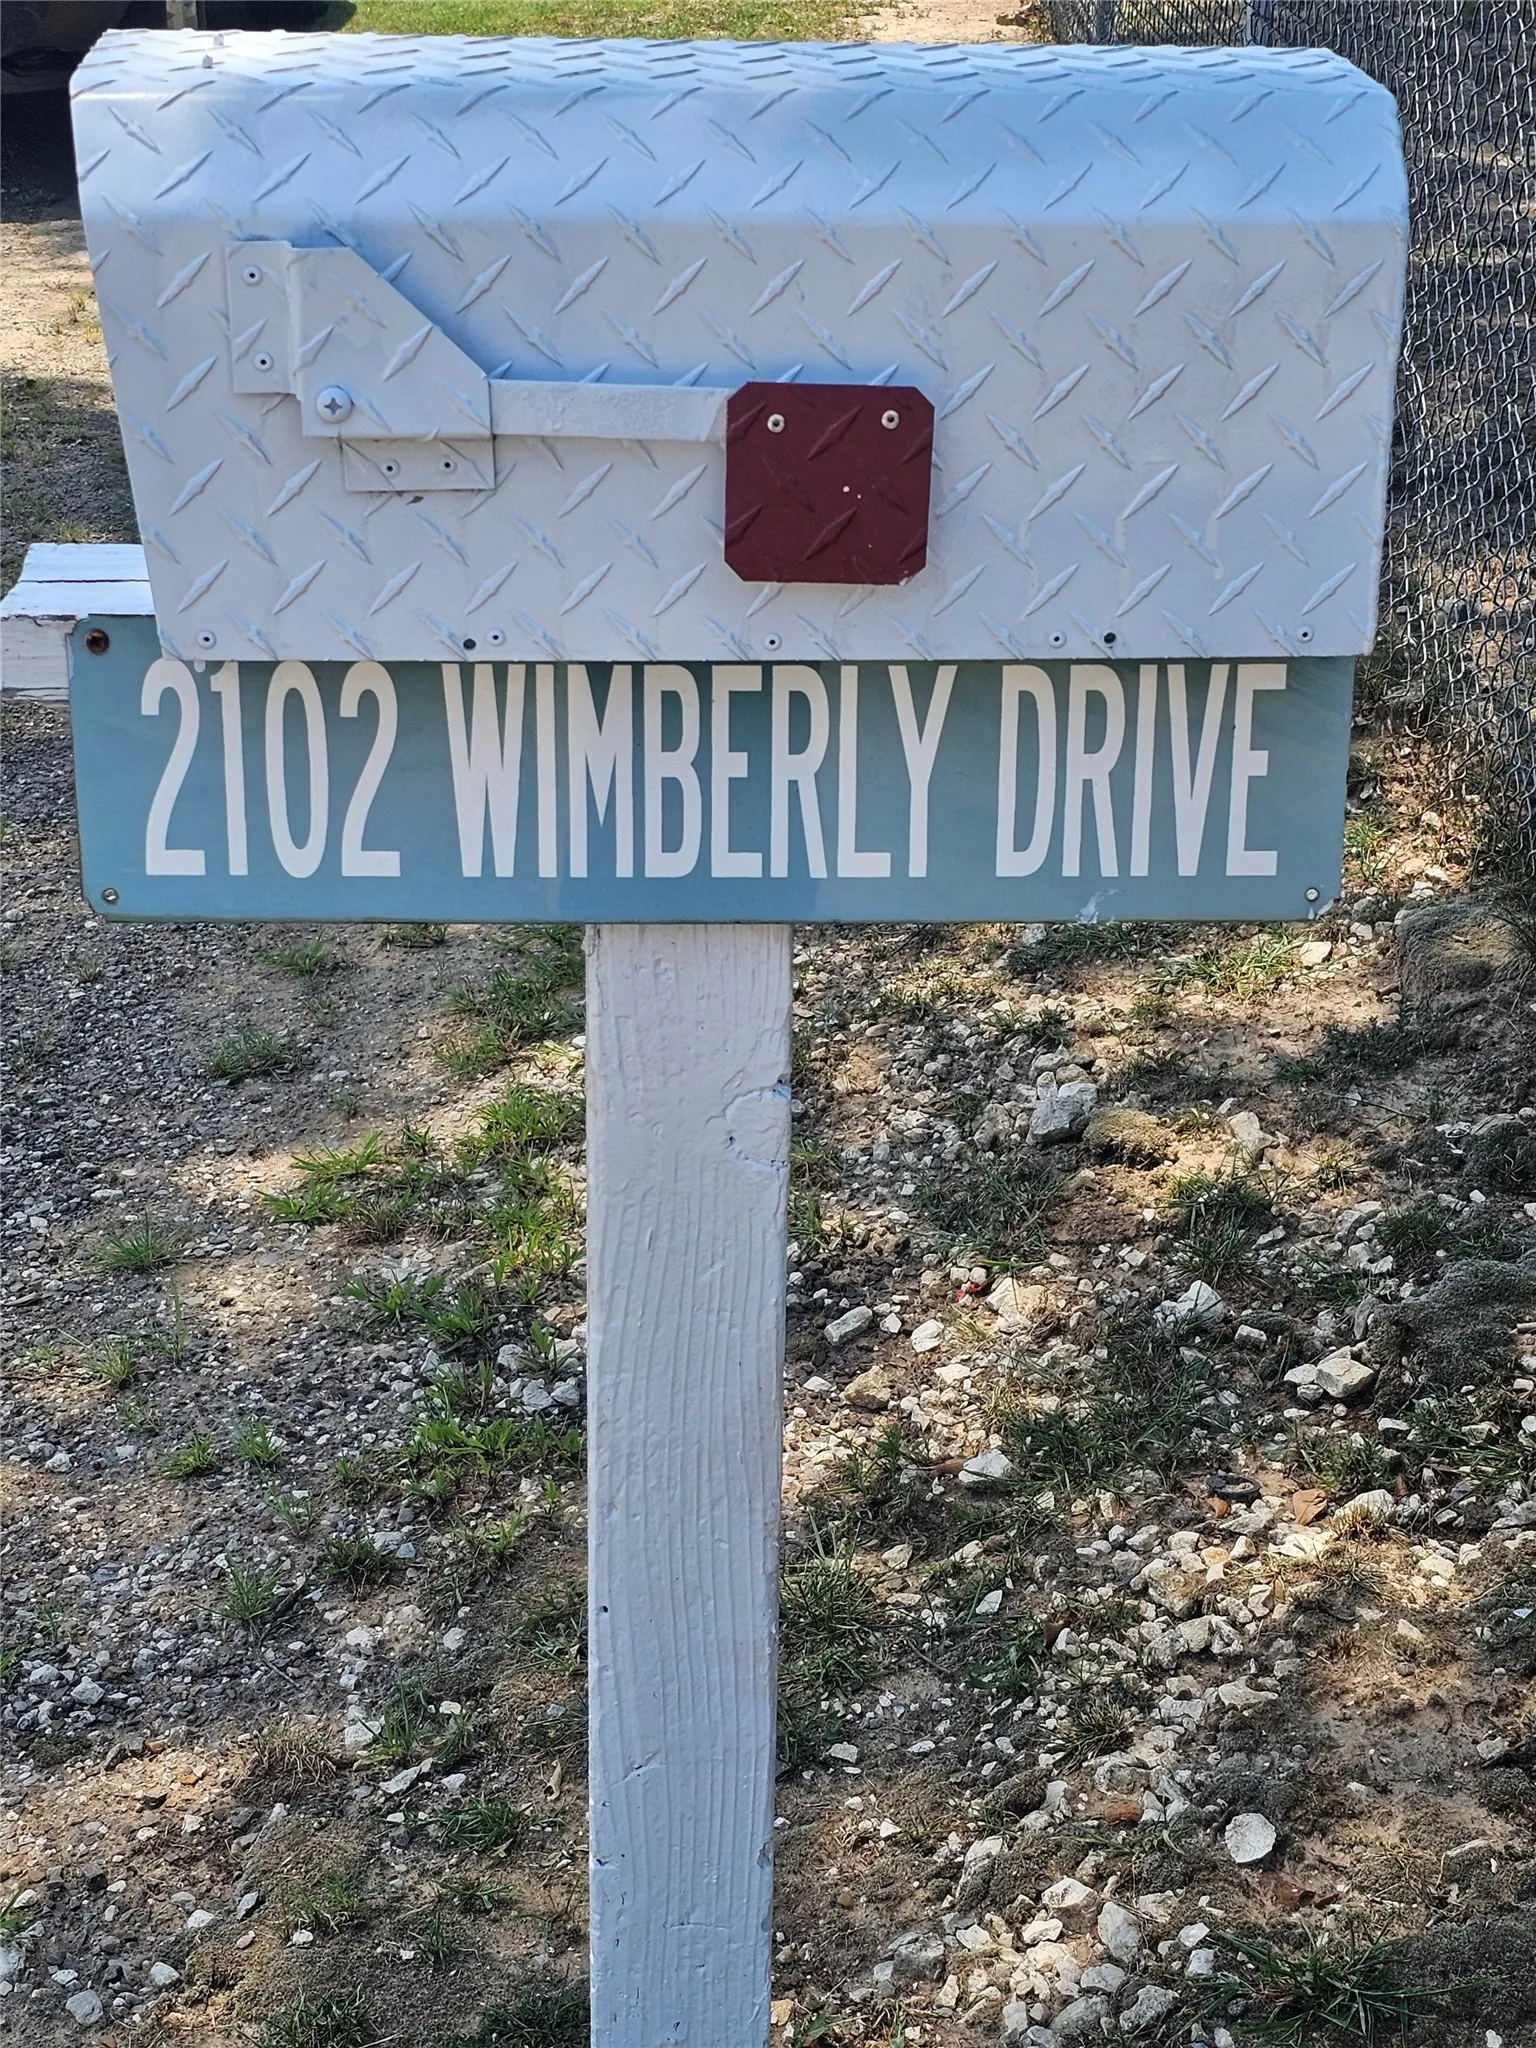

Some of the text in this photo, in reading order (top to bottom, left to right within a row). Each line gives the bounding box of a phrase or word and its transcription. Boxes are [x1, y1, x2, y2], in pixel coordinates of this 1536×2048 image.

[140, 661, 1287, 878] 2102 WIMBERLY DRIVE
